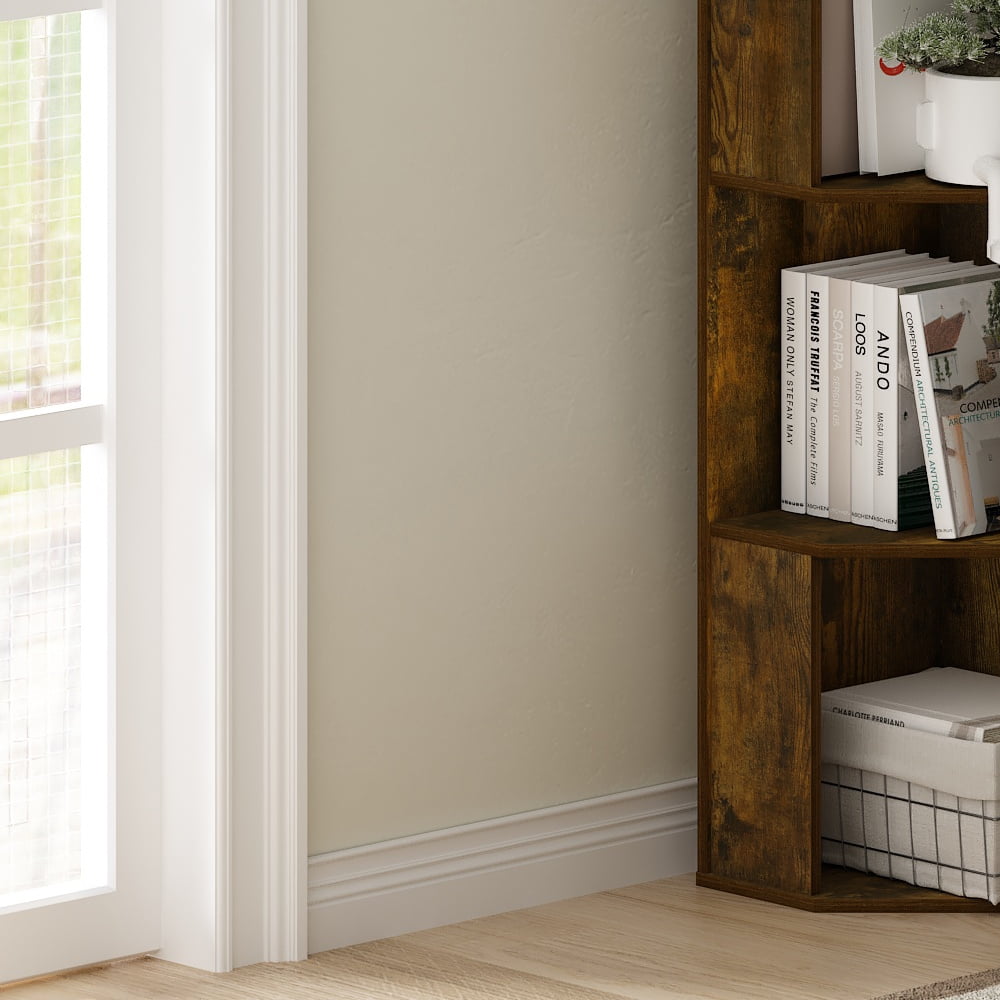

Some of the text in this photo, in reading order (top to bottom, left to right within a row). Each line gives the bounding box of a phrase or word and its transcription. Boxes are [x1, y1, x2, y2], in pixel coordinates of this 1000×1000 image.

[786, 297, 795, 342] WOMAN
[832, 308, 845, 371] SCARPA
[786, 346, 795, 377] ONLY
[810, 290, 820, 486] FRANCOIS TRUFFAT The Complete Films
[855, 313, 866, 447] LOOS AUGUST SARNITZ
[877, 330, 890, 390] ANDO
[786, 380, 794, 420] STEFAN
[905, 311, 943, 510] COMPENDIUM ARCHITECTURAL ANTIQUES
[832, 706, 870, 721] CHARLOTTE
